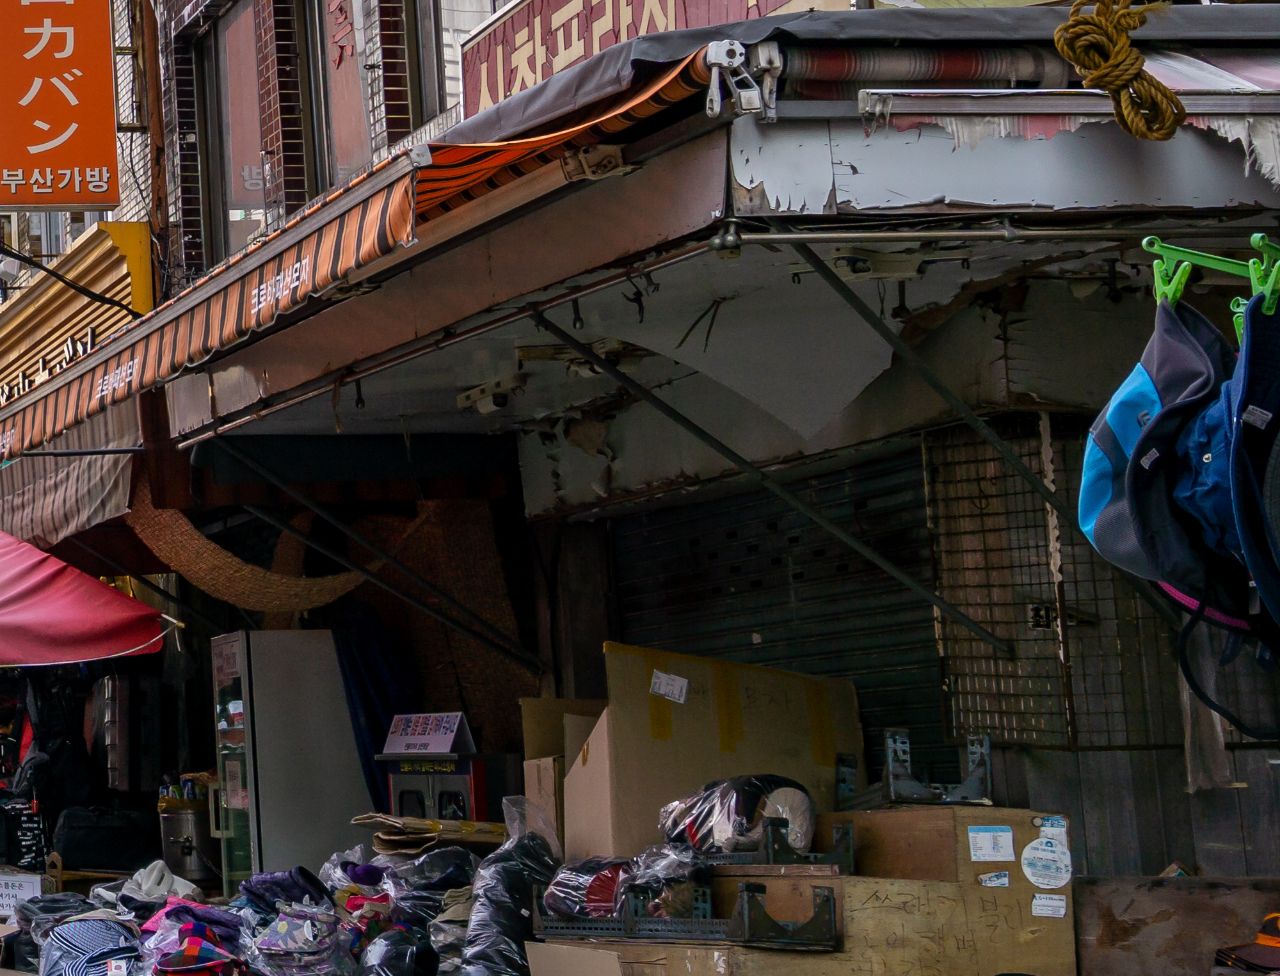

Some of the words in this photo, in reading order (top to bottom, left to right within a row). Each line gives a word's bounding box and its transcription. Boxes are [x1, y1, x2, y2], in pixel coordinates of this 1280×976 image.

[19, 0, 83, 155] カバン
[0, 167, 110, 194] 부산가방
